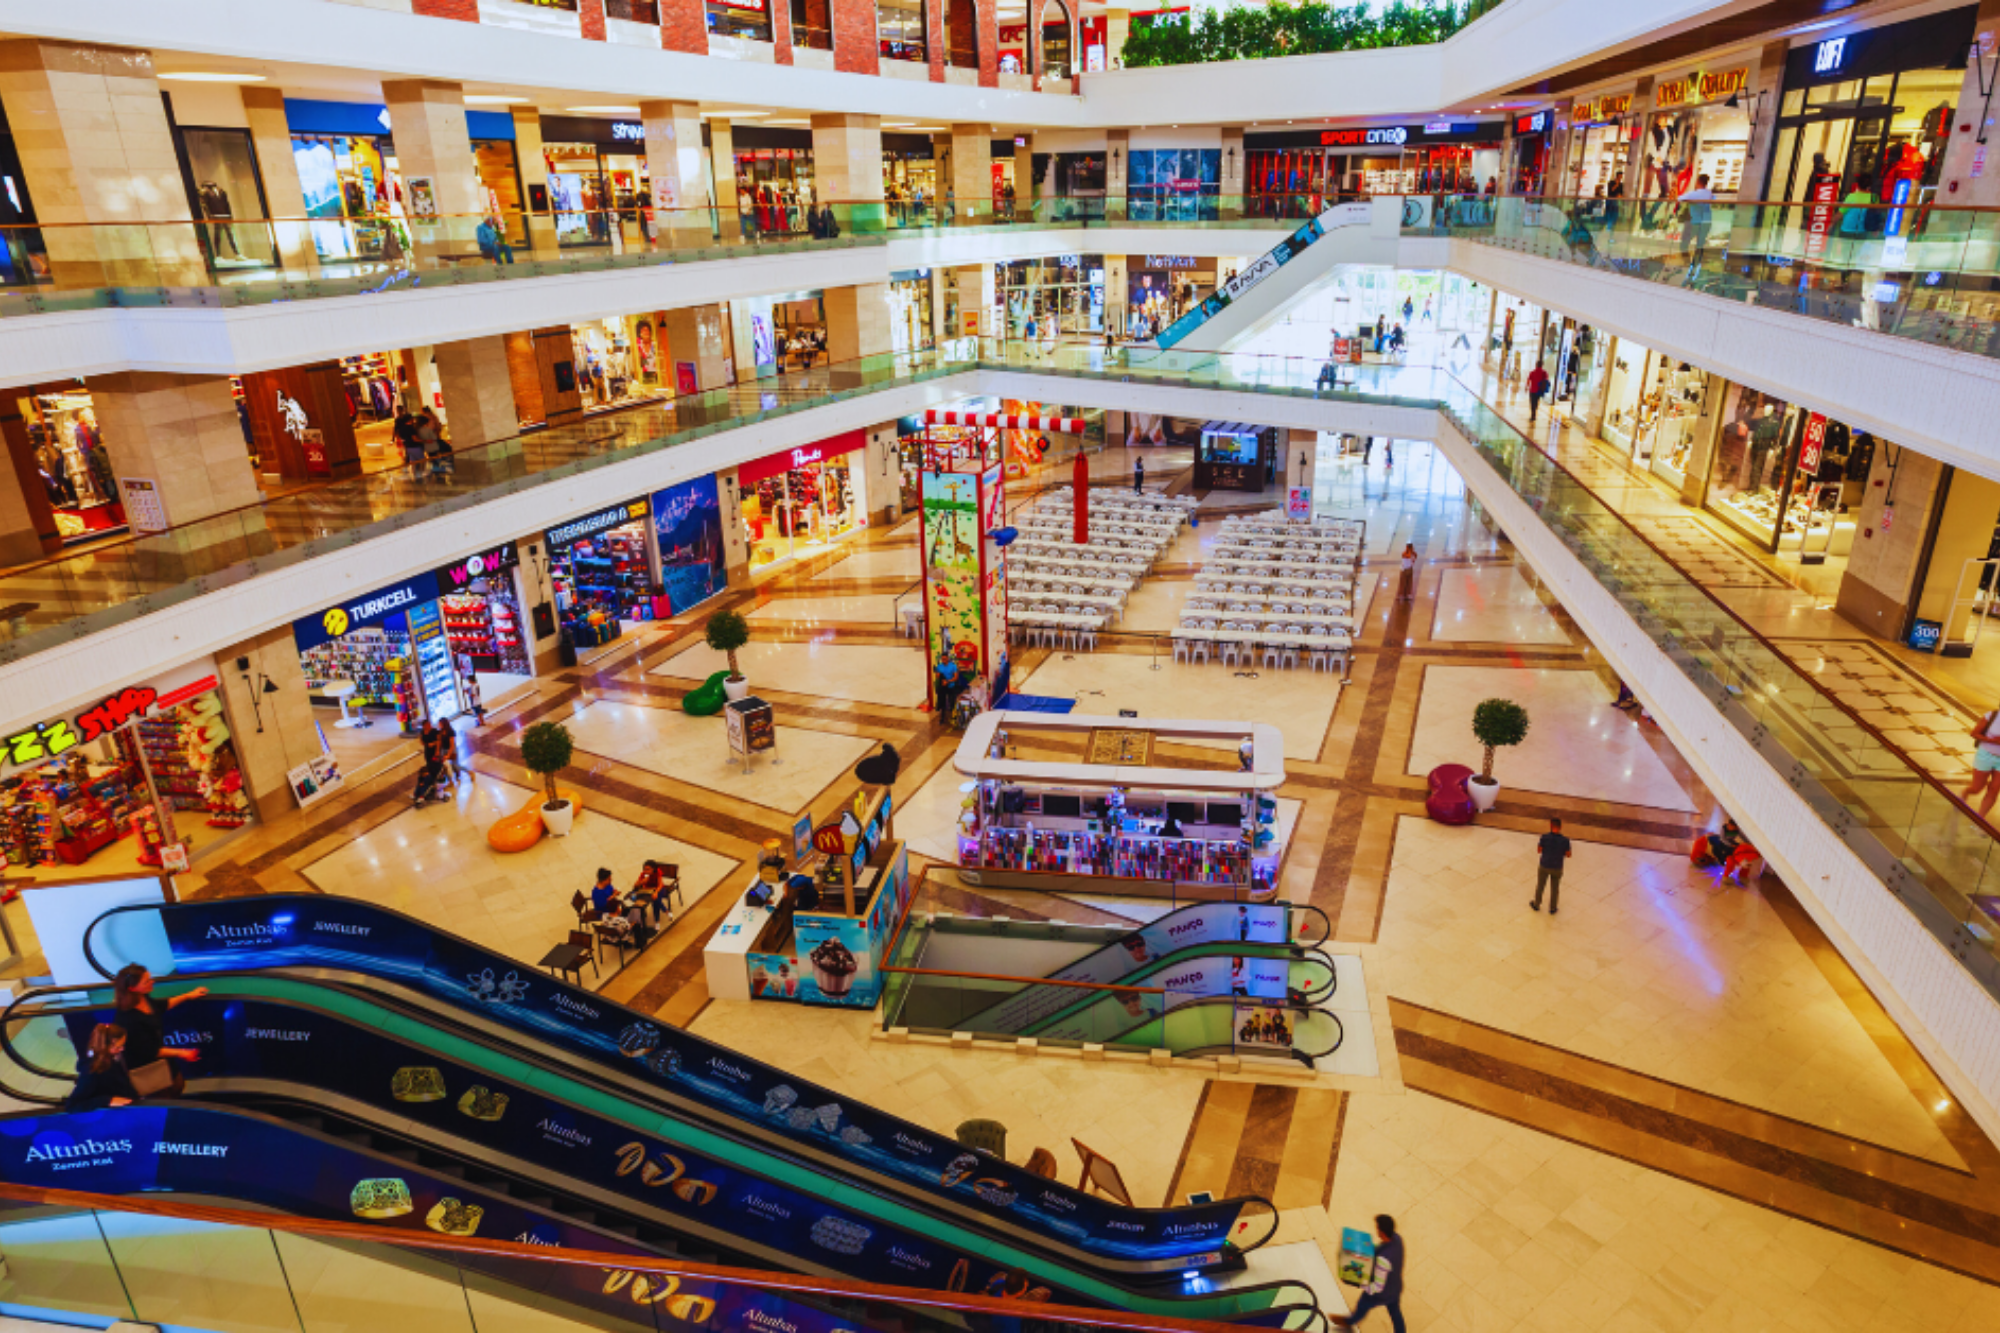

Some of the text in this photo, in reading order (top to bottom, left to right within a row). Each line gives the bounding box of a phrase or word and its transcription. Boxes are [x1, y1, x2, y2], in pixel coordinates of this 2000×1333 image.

[350, 587, 417, 623] TURKCELL
[77, 687, 157, 743] SHOP
[245, 1027, 311, 1042] JEWELLERY
[151, 1141, 229, 1158] JEWELLERY
